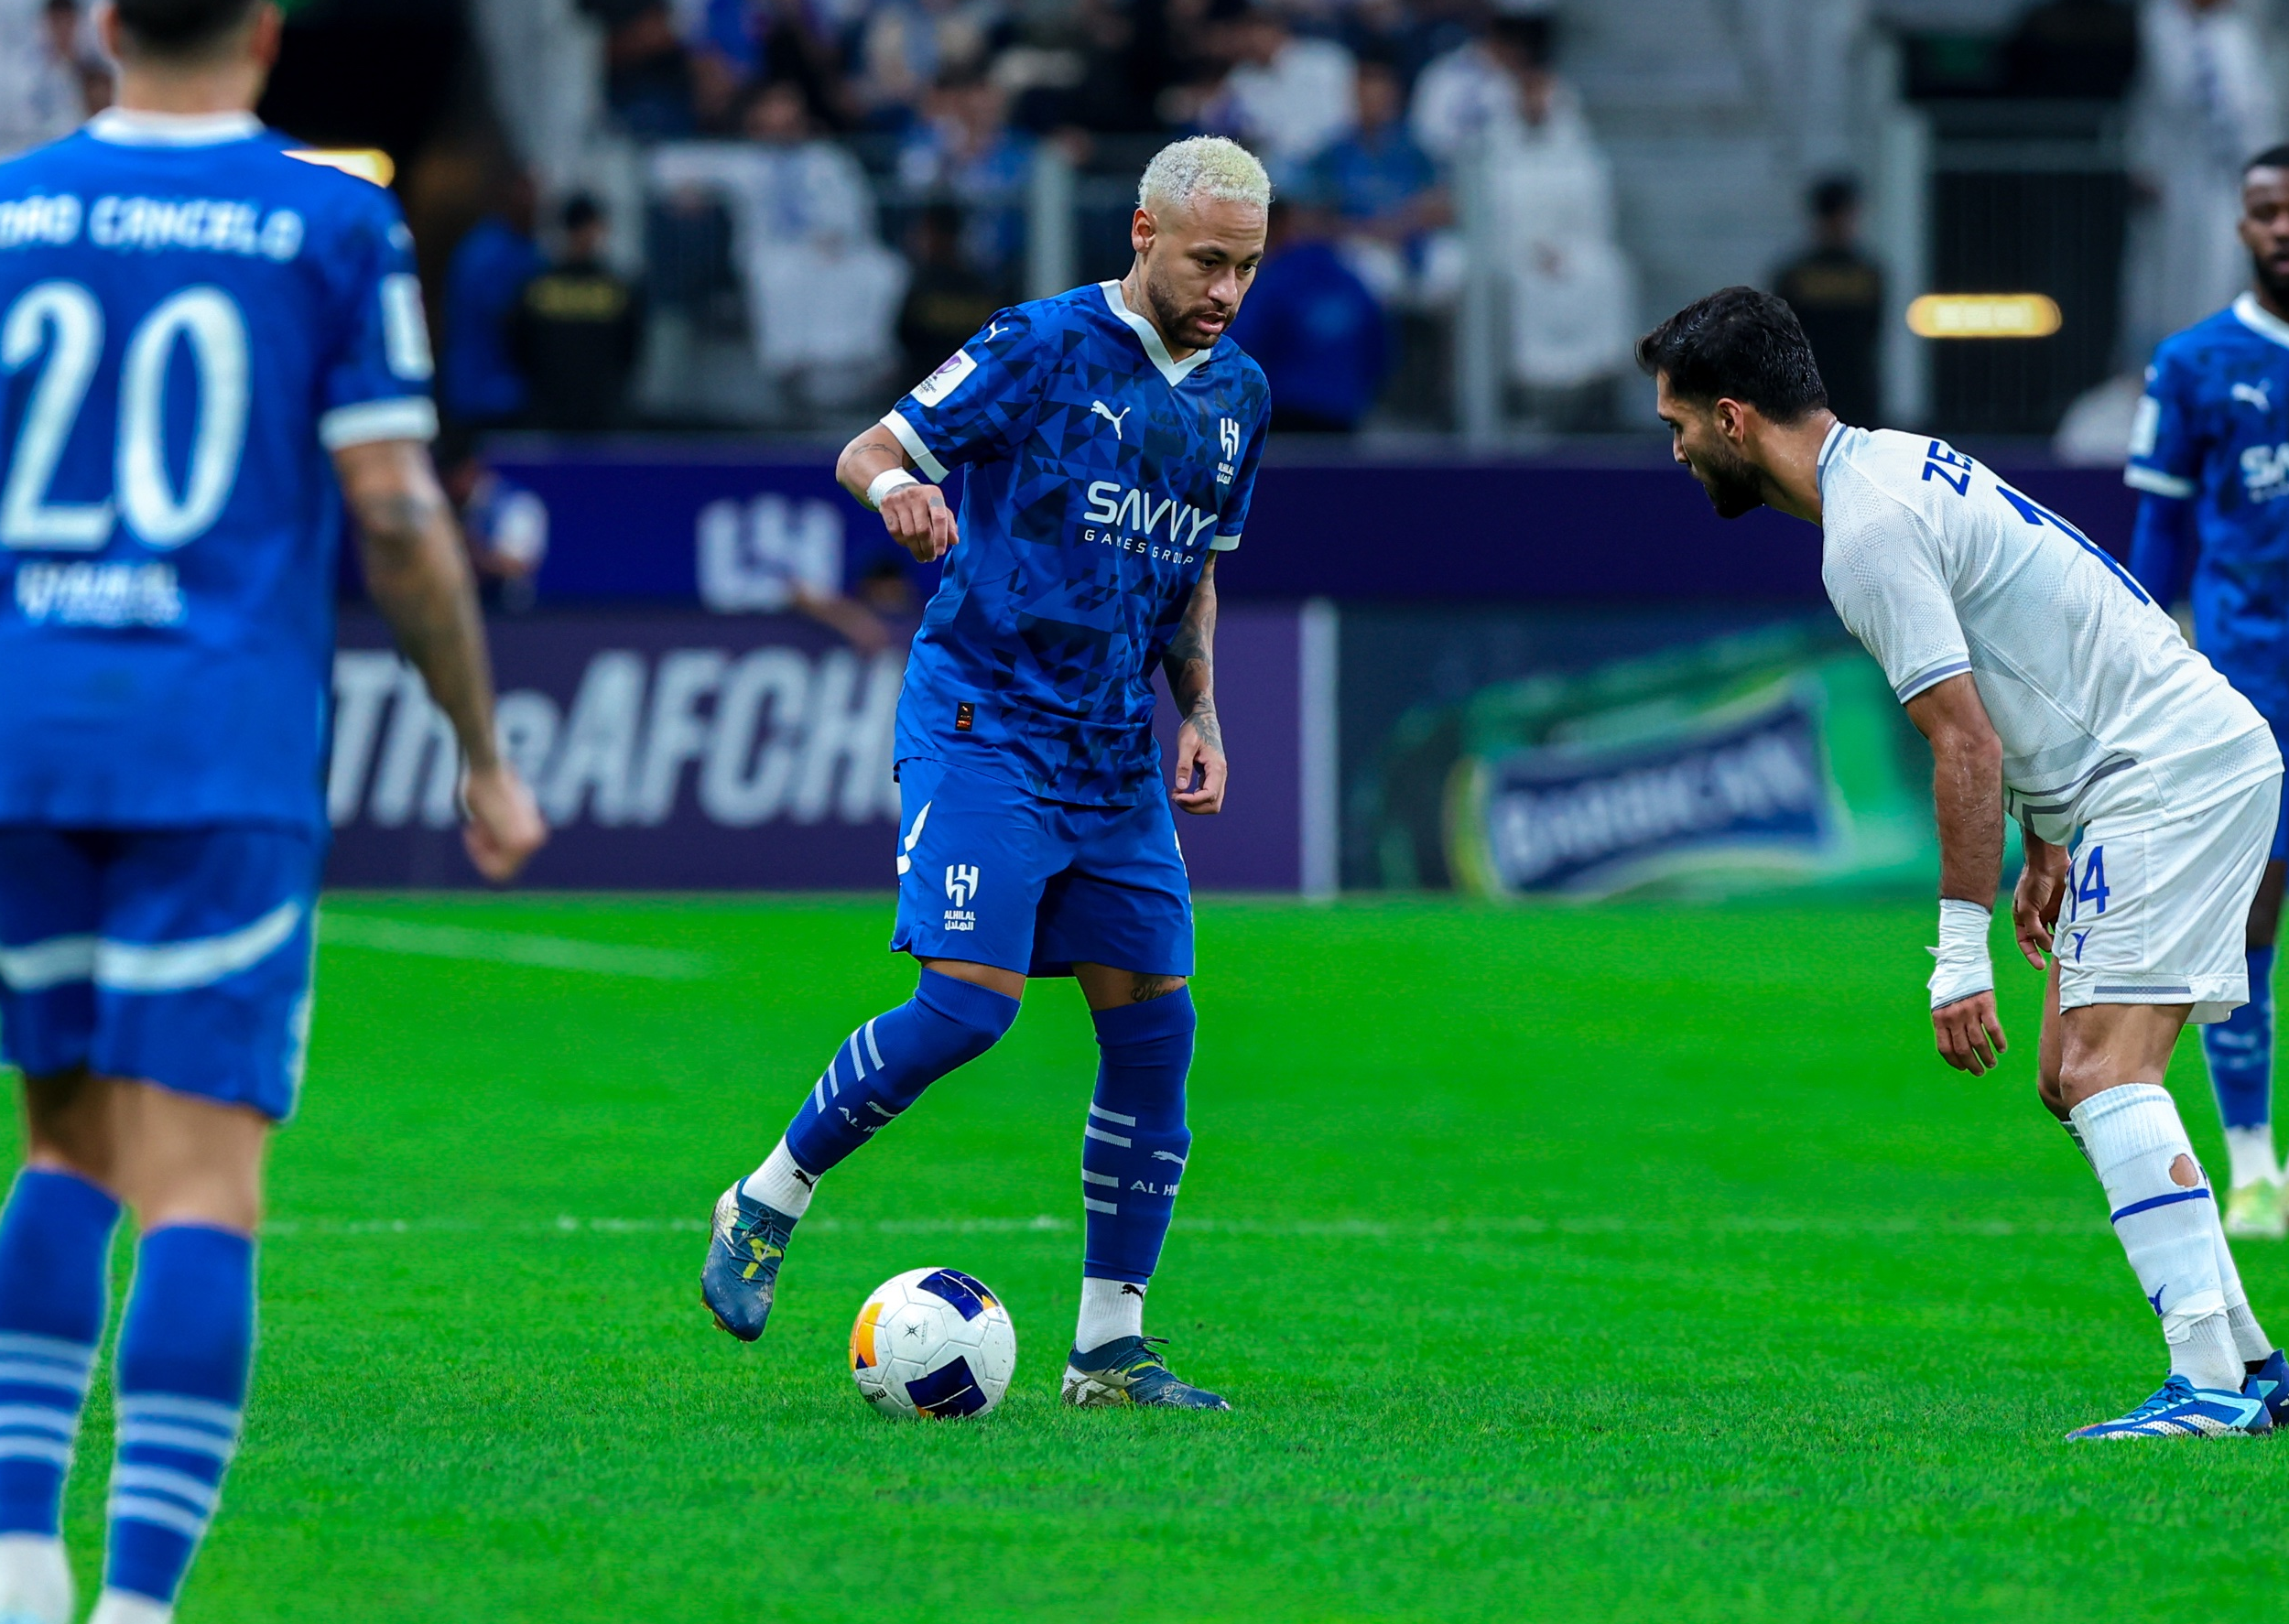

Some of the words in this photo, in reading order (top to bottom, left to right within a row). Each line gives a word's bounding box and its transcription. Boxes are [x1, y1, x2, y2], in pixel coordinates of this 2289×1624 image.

[0, 279, 255, 551] 20
[1922, 440, 1973, 496] ZE
[1084, 481, 1218, 547] SAVVY
[1084, 529, 1147, 554] GAMES
[1152, 546, 1194, 565] GROUP
[1996, 484, 2150, 606] 1
[328, 646, 903, 824] TheAFCH
[2067, 845, 2110, 923] 14
[944, 910, 976, 921] ALHILAL
[945, 920, 974, 931] الهلال
[838, 1107, 858, 1128] AL
[1130, 1179, 1157, 1194] AL
